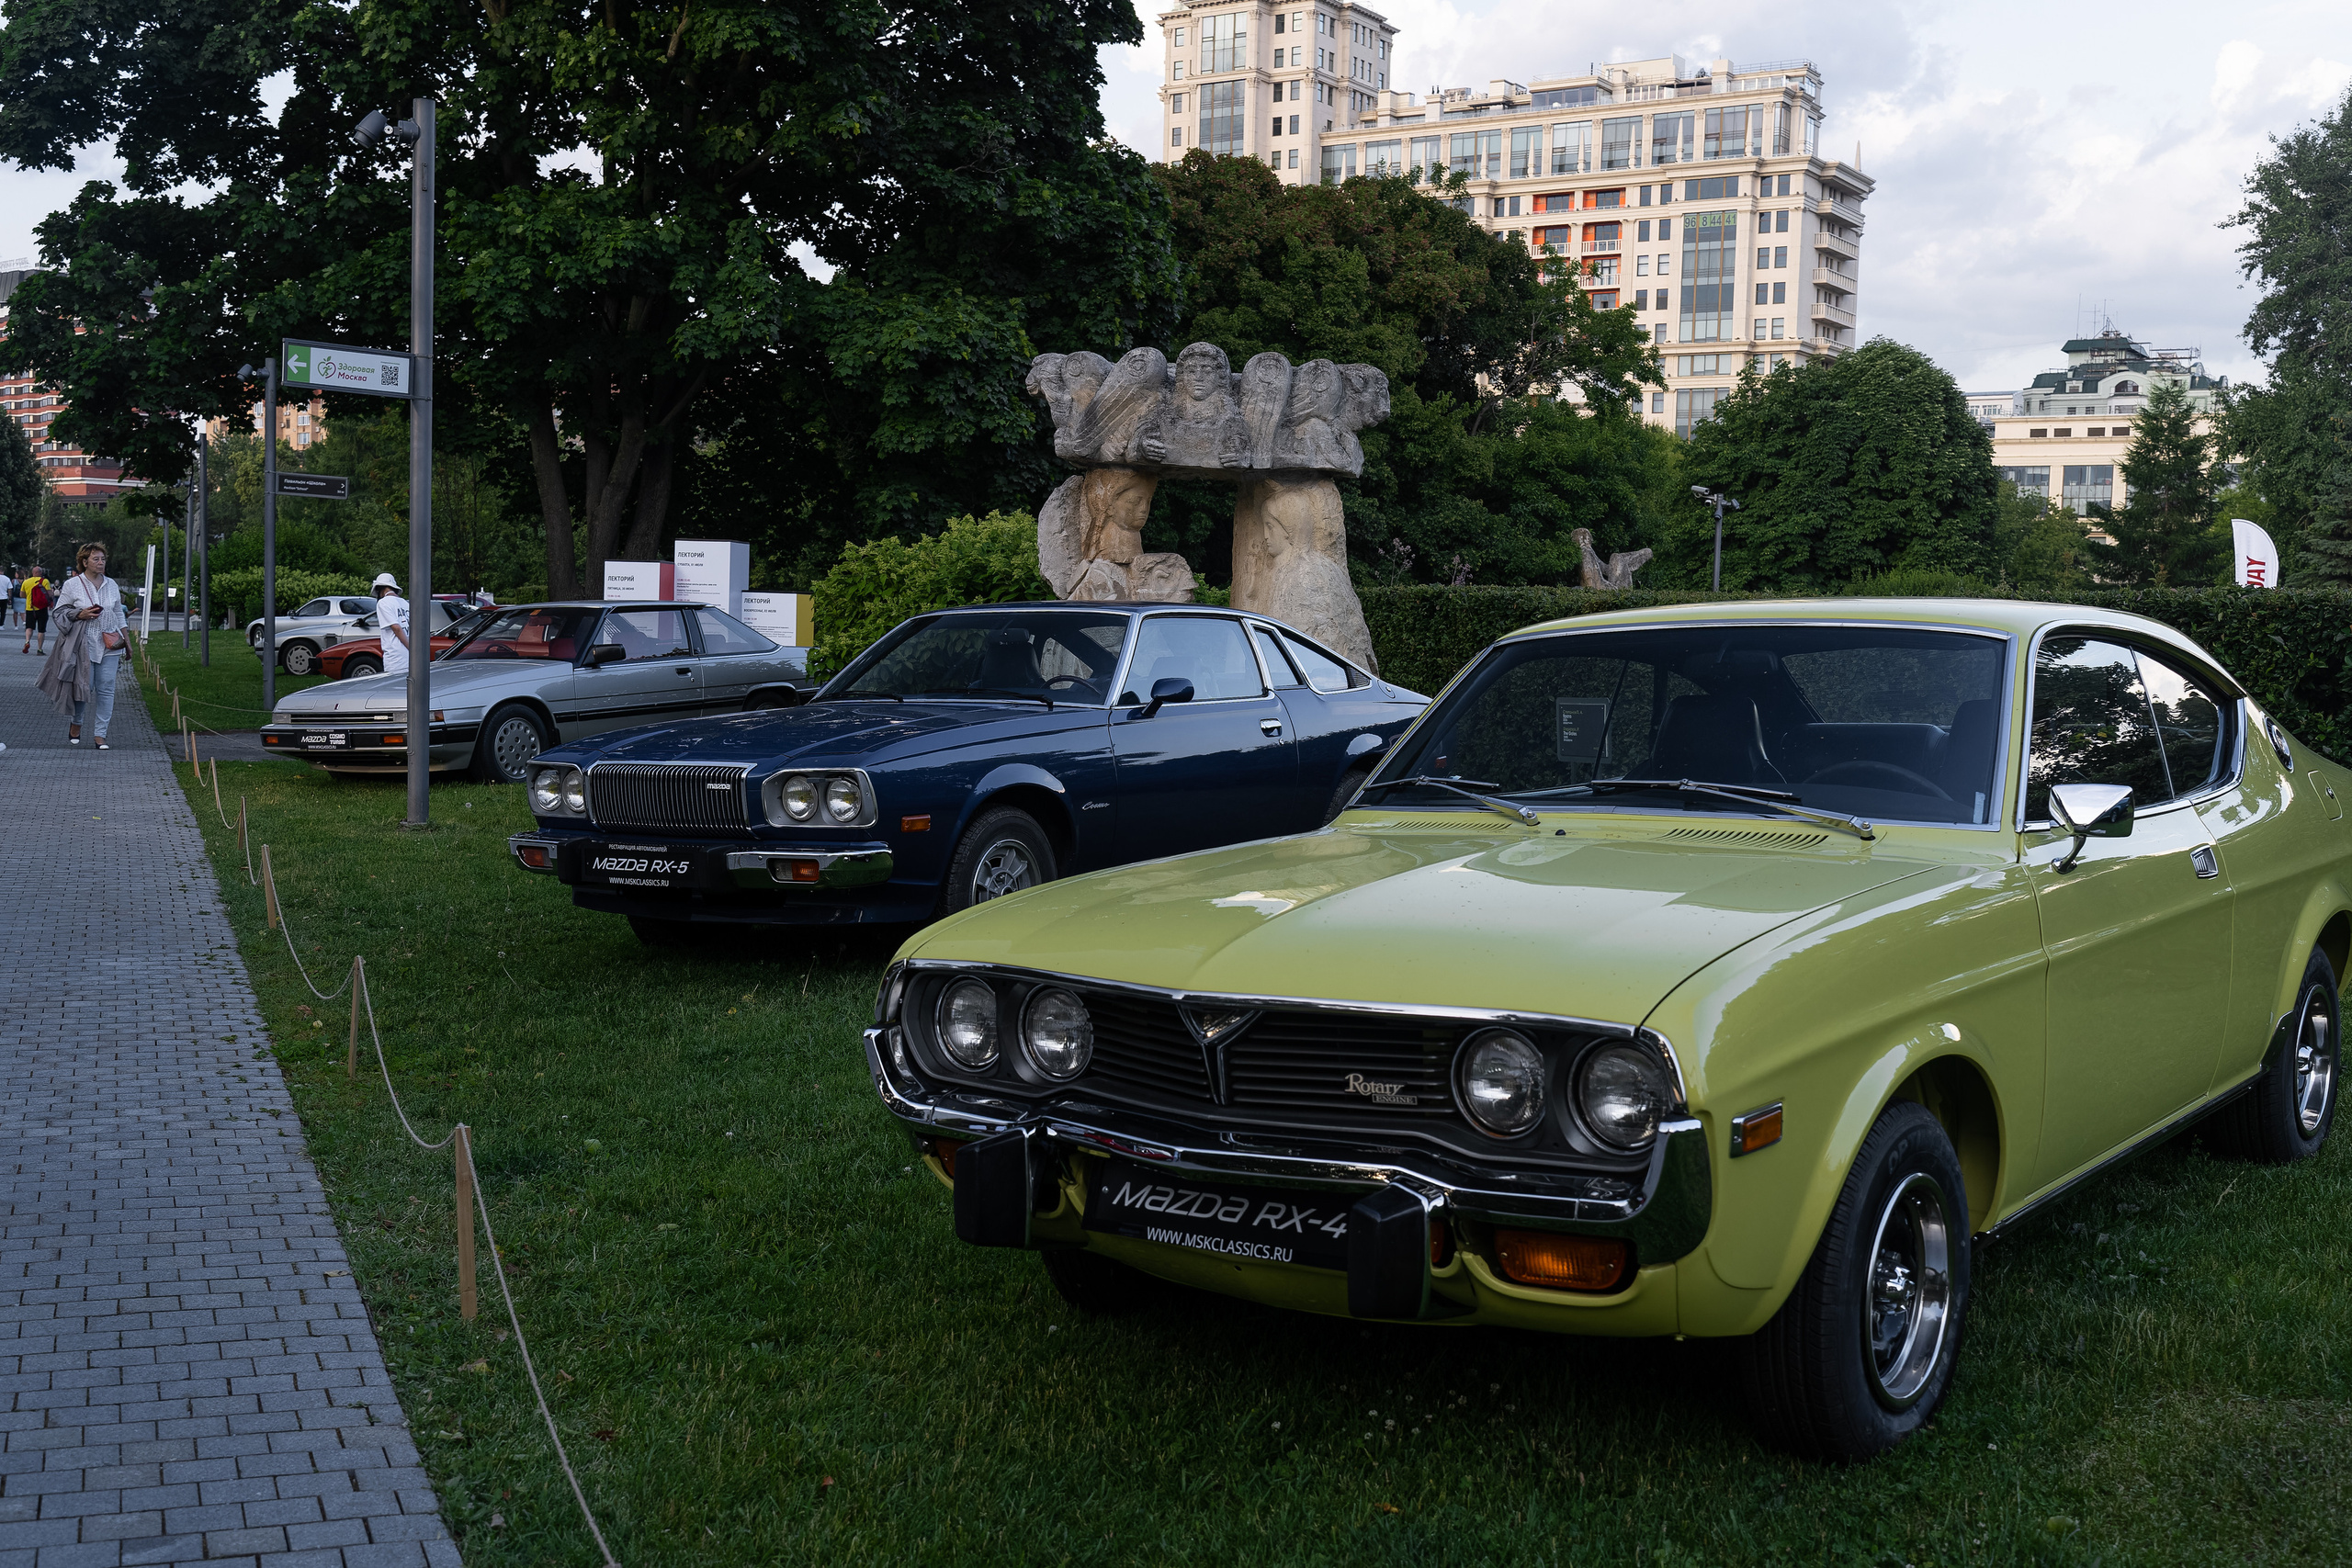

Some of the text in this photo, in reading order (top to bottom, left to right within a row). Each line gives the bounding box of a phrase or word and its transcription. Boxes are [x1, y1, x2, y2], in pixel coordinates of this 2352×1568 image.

[337, 363, 376, 374] Здоровая
[337, 372, 368, 382] Москва
[608, 843, 636, 852] РЕСТАВРАЦИЯ
[650, 860, 690, 874] RX-5
[608, 876, 670, 887] WWW.MSKCLASSICS.RU
[1344, 1073, 1405, 1096] Rotary
[1375, 1095, 1414, 1104] ENGINE
[1252, 1201, 1349, 1239] RX-4
[1147, 1226, 1293, 1263] WWW.MSKCLASSICS.RU
